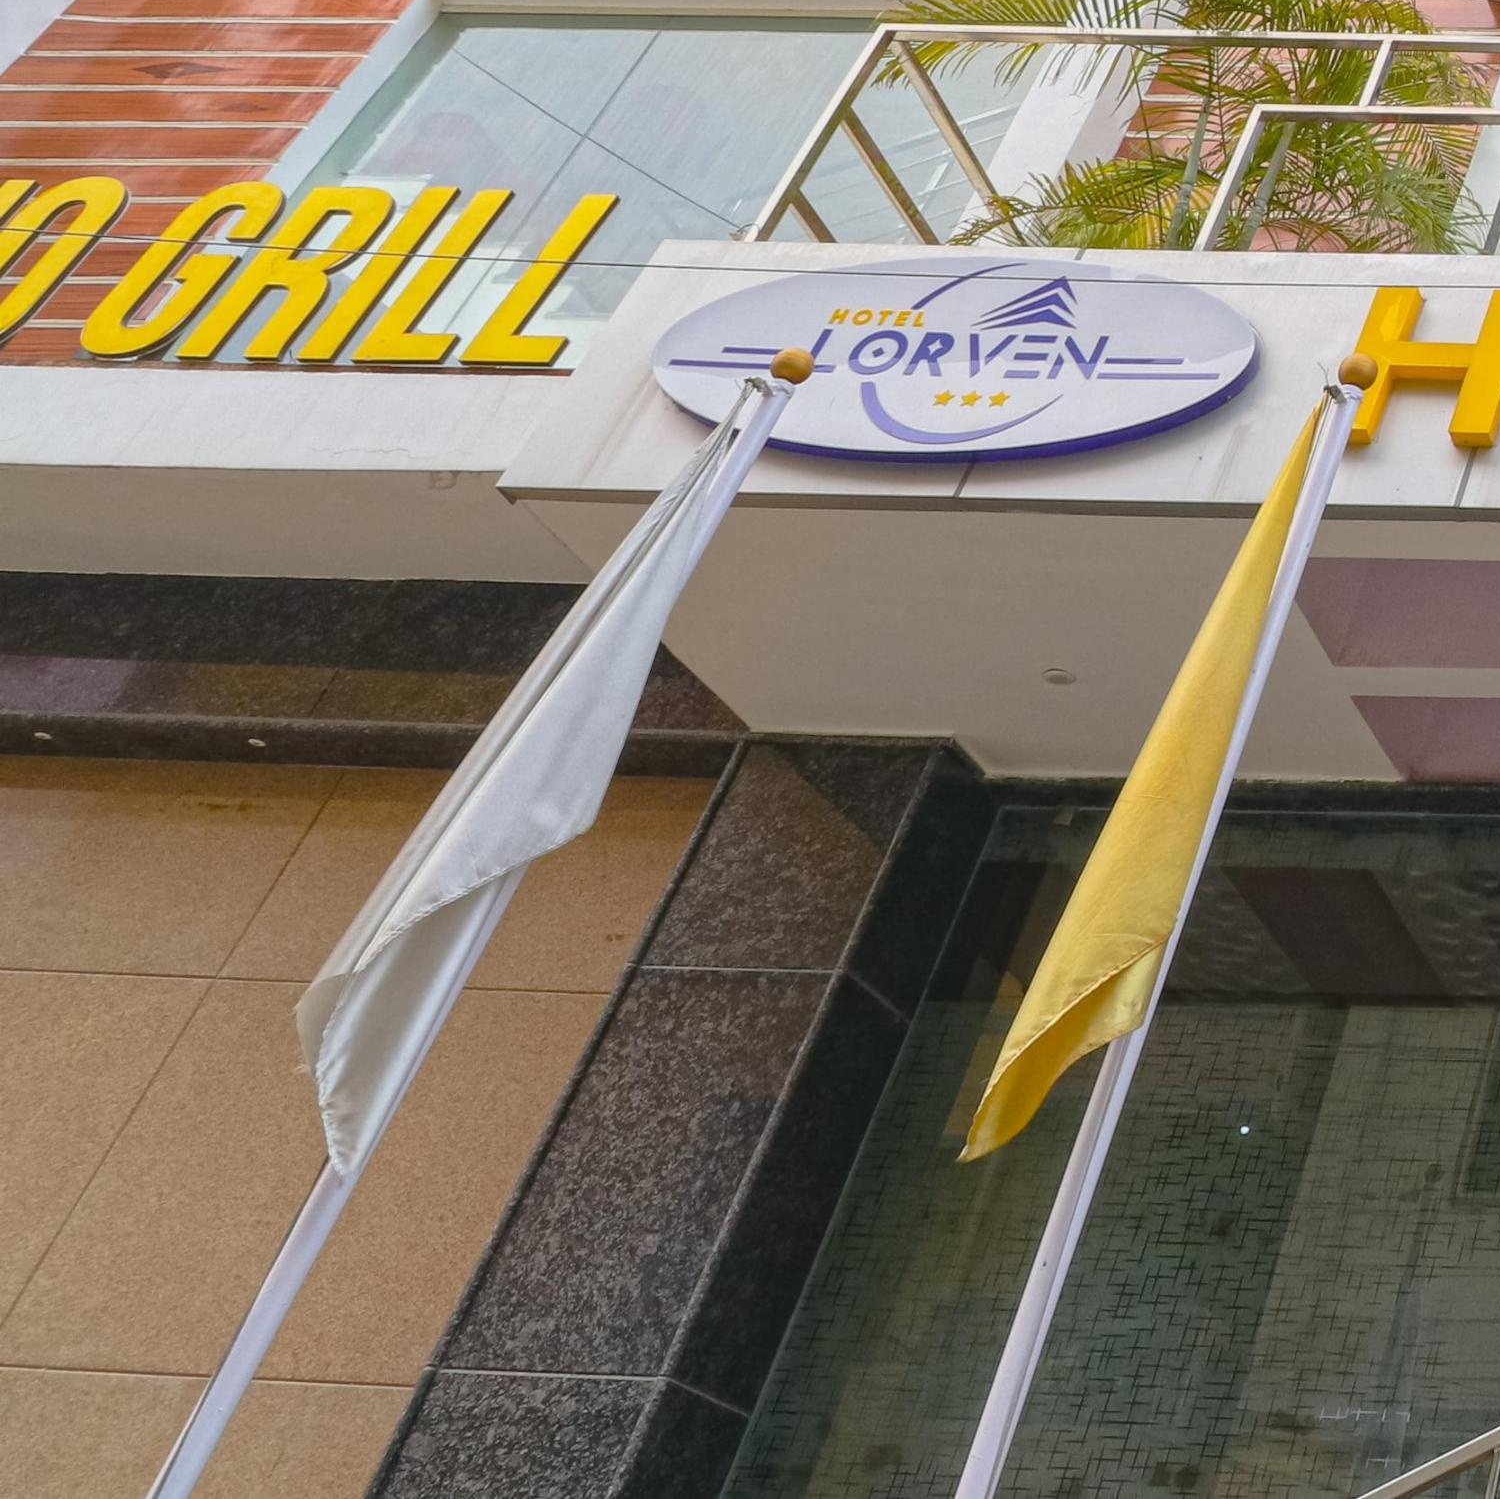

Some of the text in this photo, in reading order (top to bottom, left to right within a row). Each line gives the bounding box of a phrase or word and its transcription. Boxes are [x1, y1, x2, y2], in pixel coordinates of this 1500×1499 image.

[0, 176, 620, 365] O GRILL
[829, 307, 925, 328] HOTEL
[806, 329, 1108, 379] LORVEN
